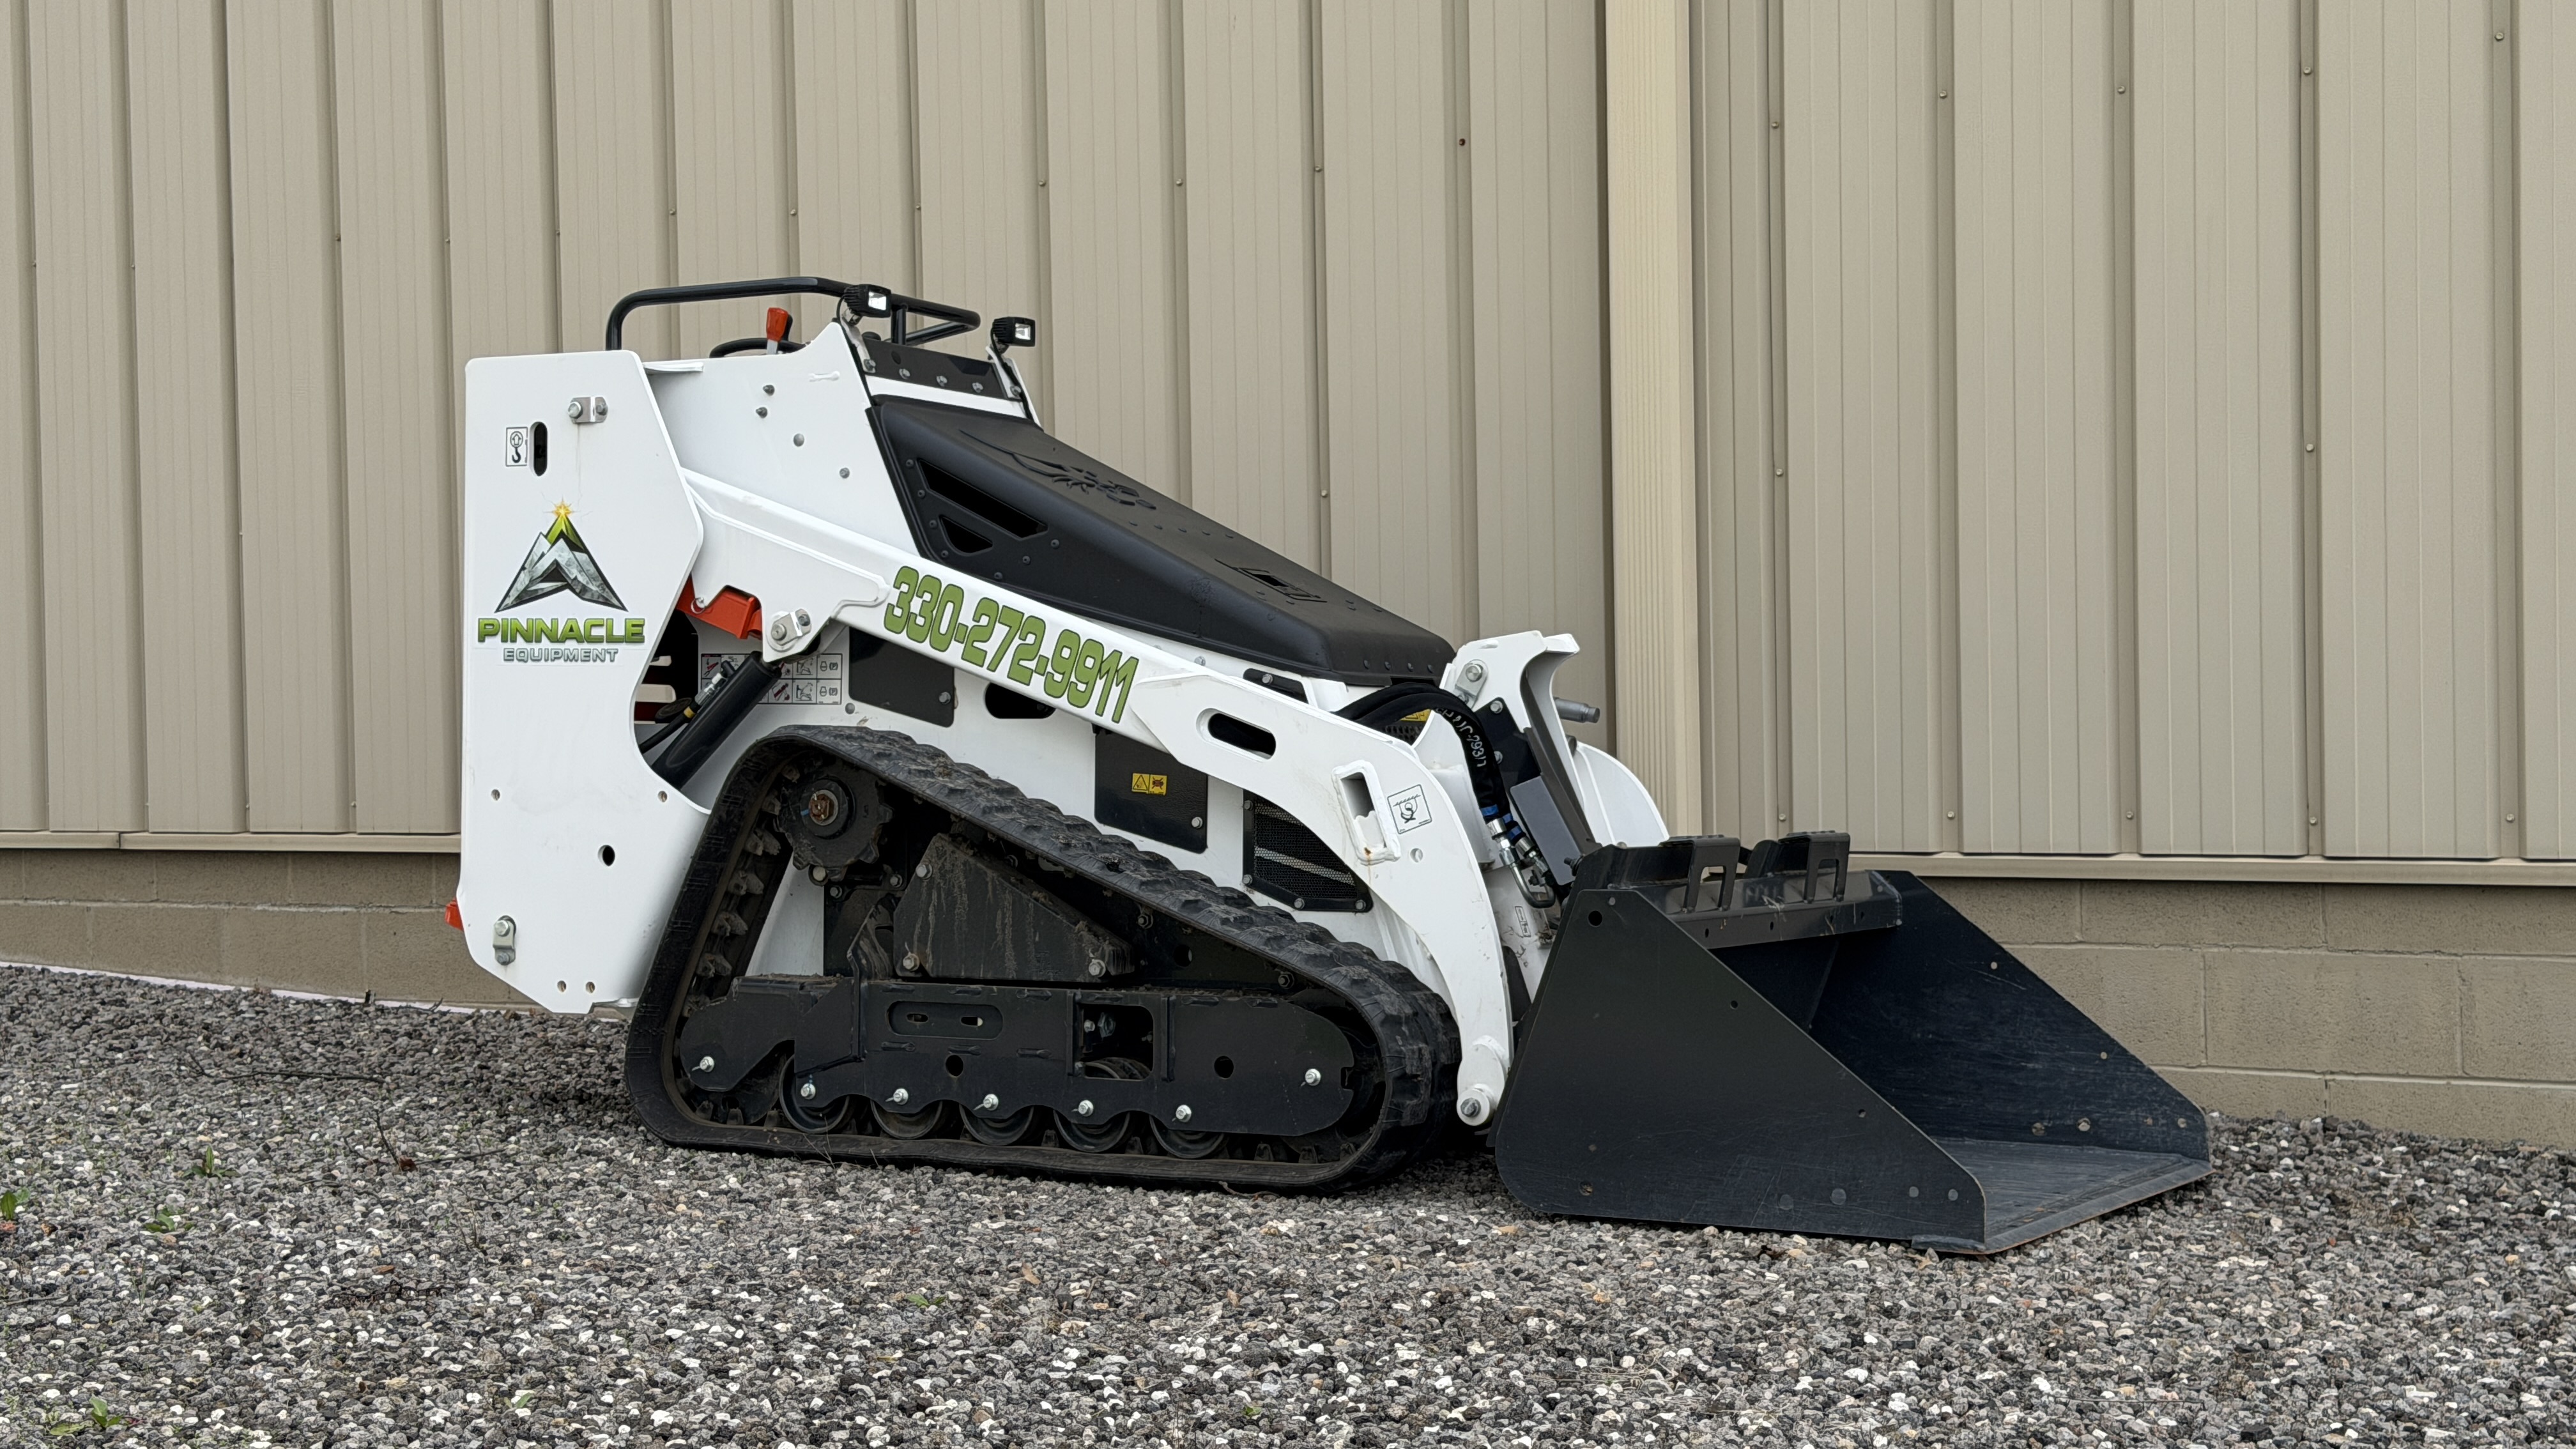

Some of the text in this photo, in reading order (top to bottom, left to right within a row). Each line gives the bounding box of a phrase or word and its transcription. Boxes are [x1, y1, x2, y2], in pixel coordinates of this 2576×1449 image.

[477, 618, 645, 644] PINNACLE
[503, 647, 618, 663] EQUIPMENT
[884, 565, 1139, 724] 330-272-9911
